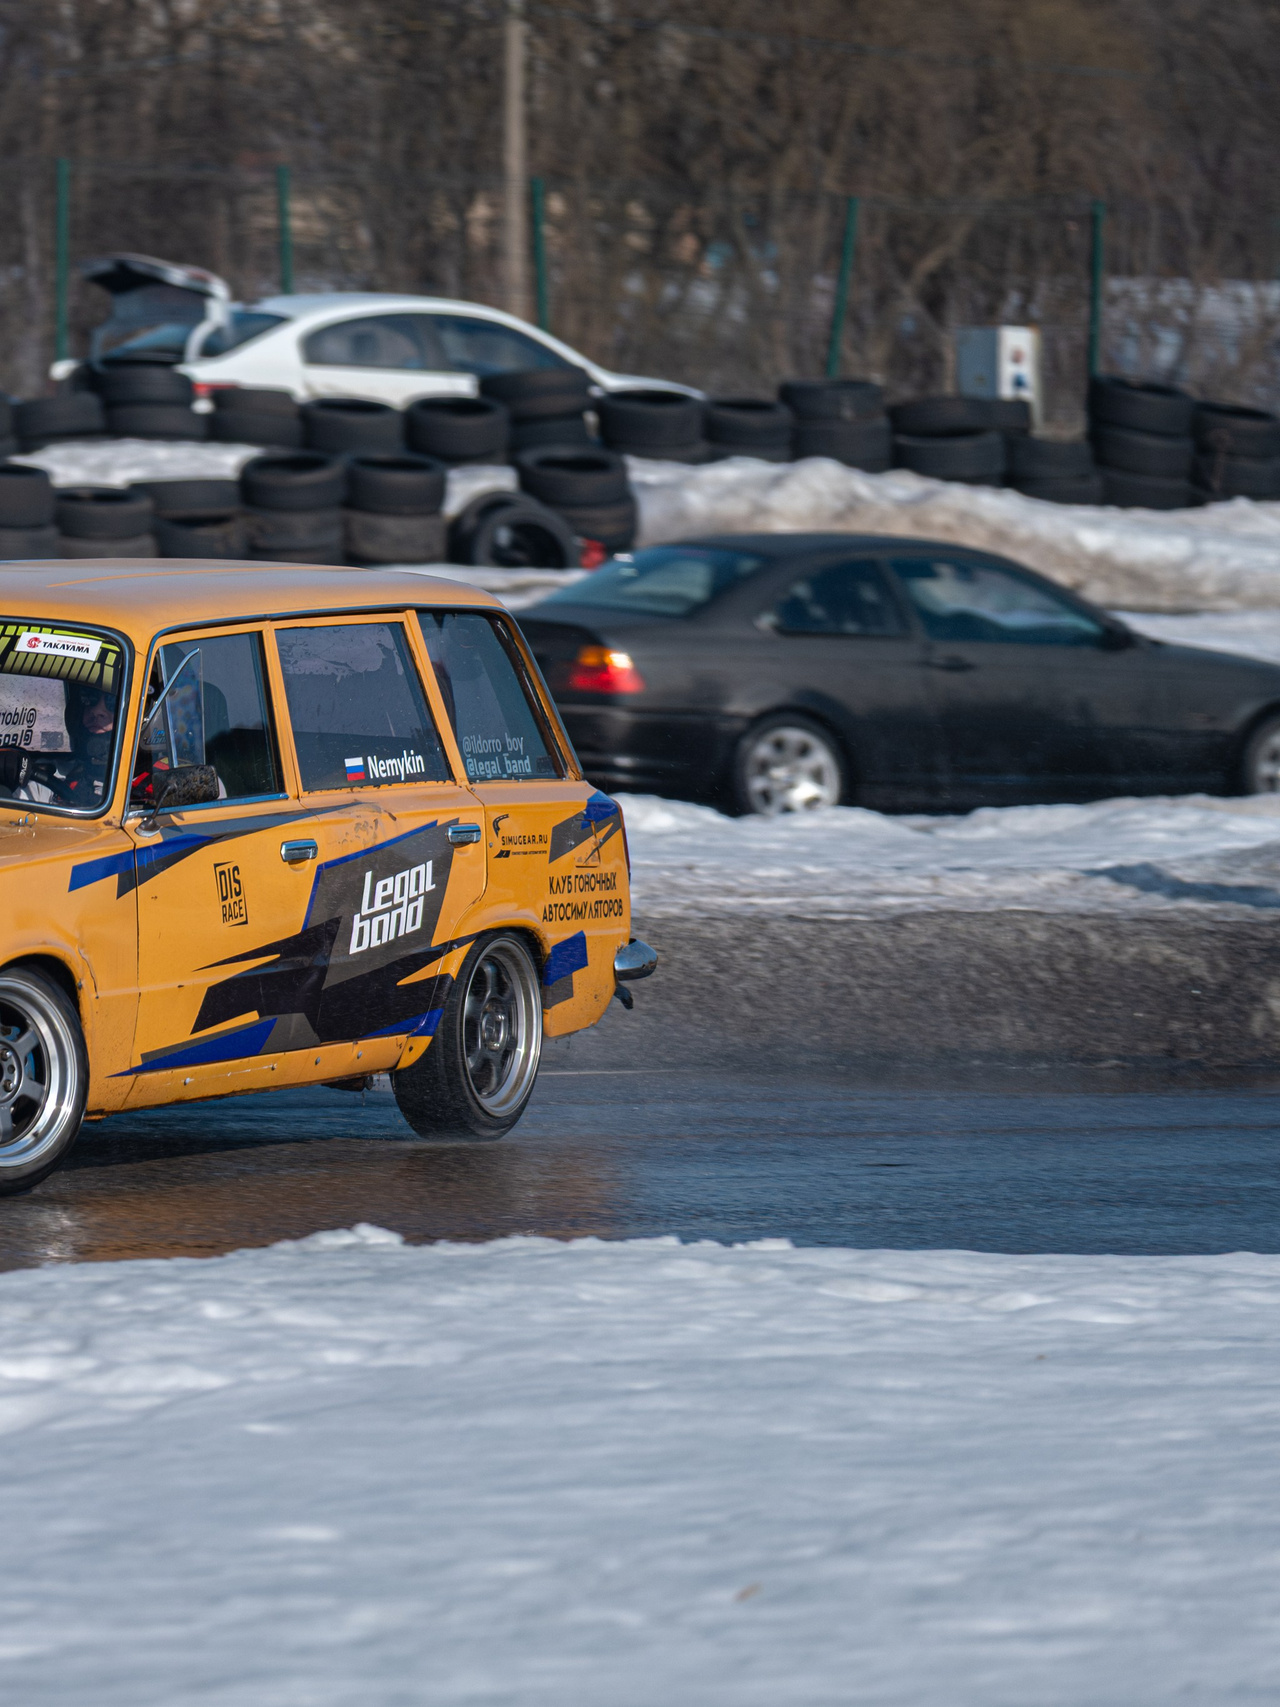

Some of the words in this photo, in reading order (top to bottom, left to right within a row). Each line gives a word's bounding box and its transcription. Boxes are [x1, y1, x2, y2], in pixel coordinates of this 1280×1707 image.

[42, 641, 90, 654] TAKAYAMA
[366, 750, 425, 781] Nemykin
[466, 755, 532, 778] @legal_band
[501, 834, 548, 846] SIMUGEAR.RU
[219, 865, 242, 902] DIS
[549, 874, 572, 895] КЛУБ
[574, 871, 617, 893] ГОНОЧНЫХ
[222, 899, 244, 923] RACE
[542, 898, 624, 922] АВТОСИМУЛЯТОРОВ
